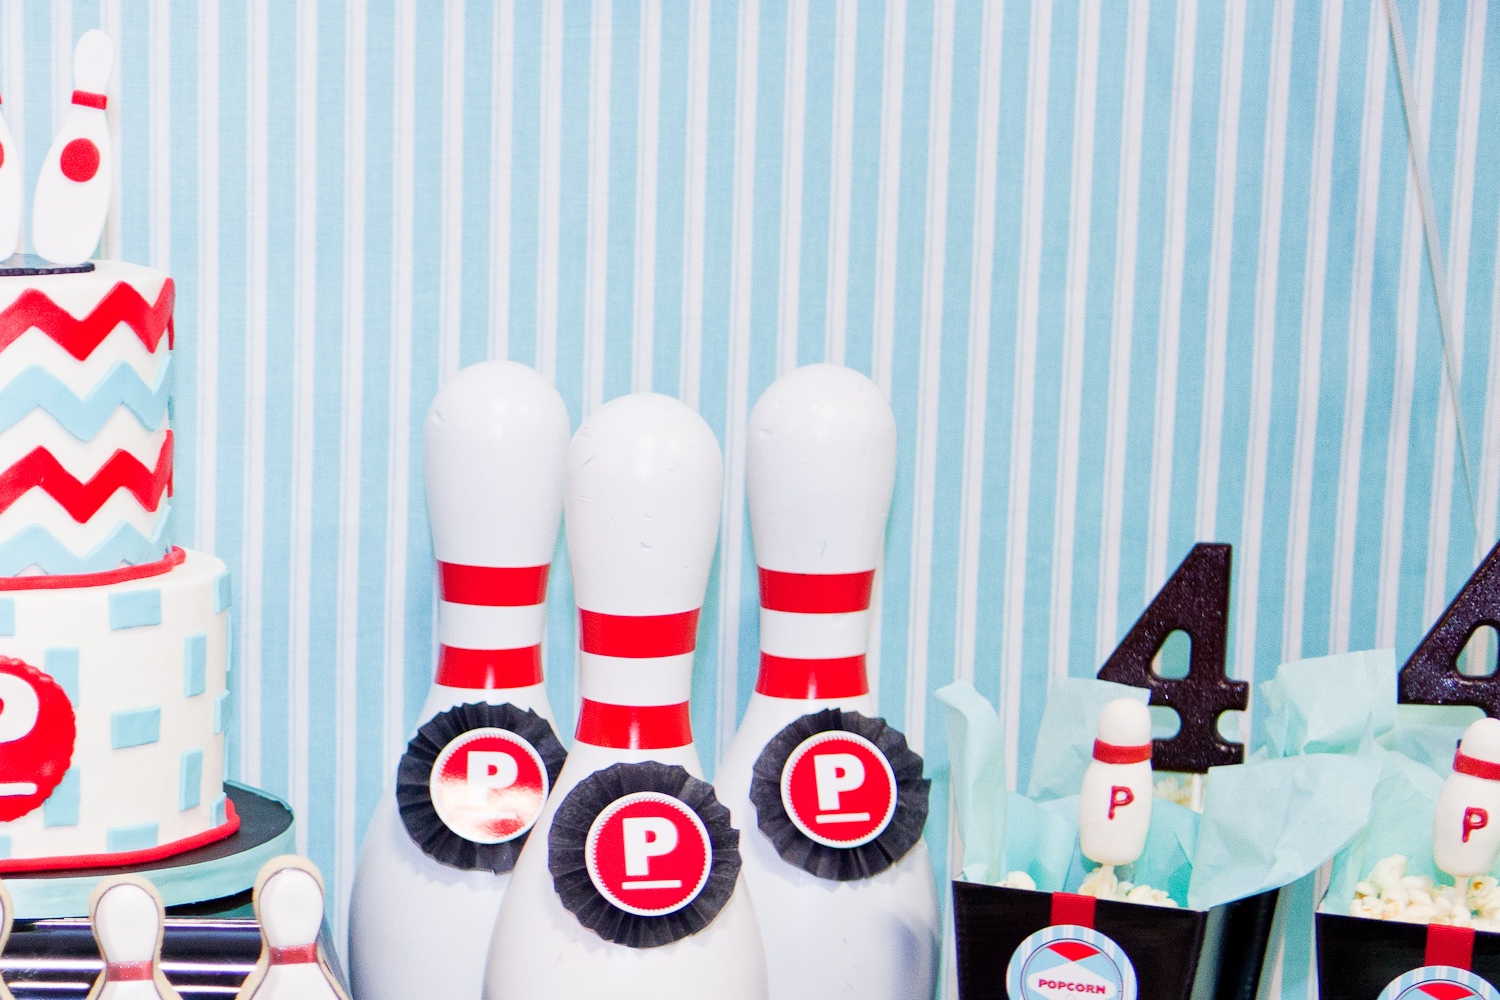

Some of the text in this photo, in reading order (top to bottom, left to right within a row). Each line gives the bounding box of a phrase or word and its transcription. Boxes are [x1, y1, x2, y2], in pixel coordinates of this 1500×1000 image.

[466, 750, 519, 804] P
[813, 752, 867, 811] P
[1108, 784, 1135, 821] P
[1461, 806, 1490, 844] P
[621, 816, 679, 877] P
[1037, 978, 1107, 995] POPCORN
